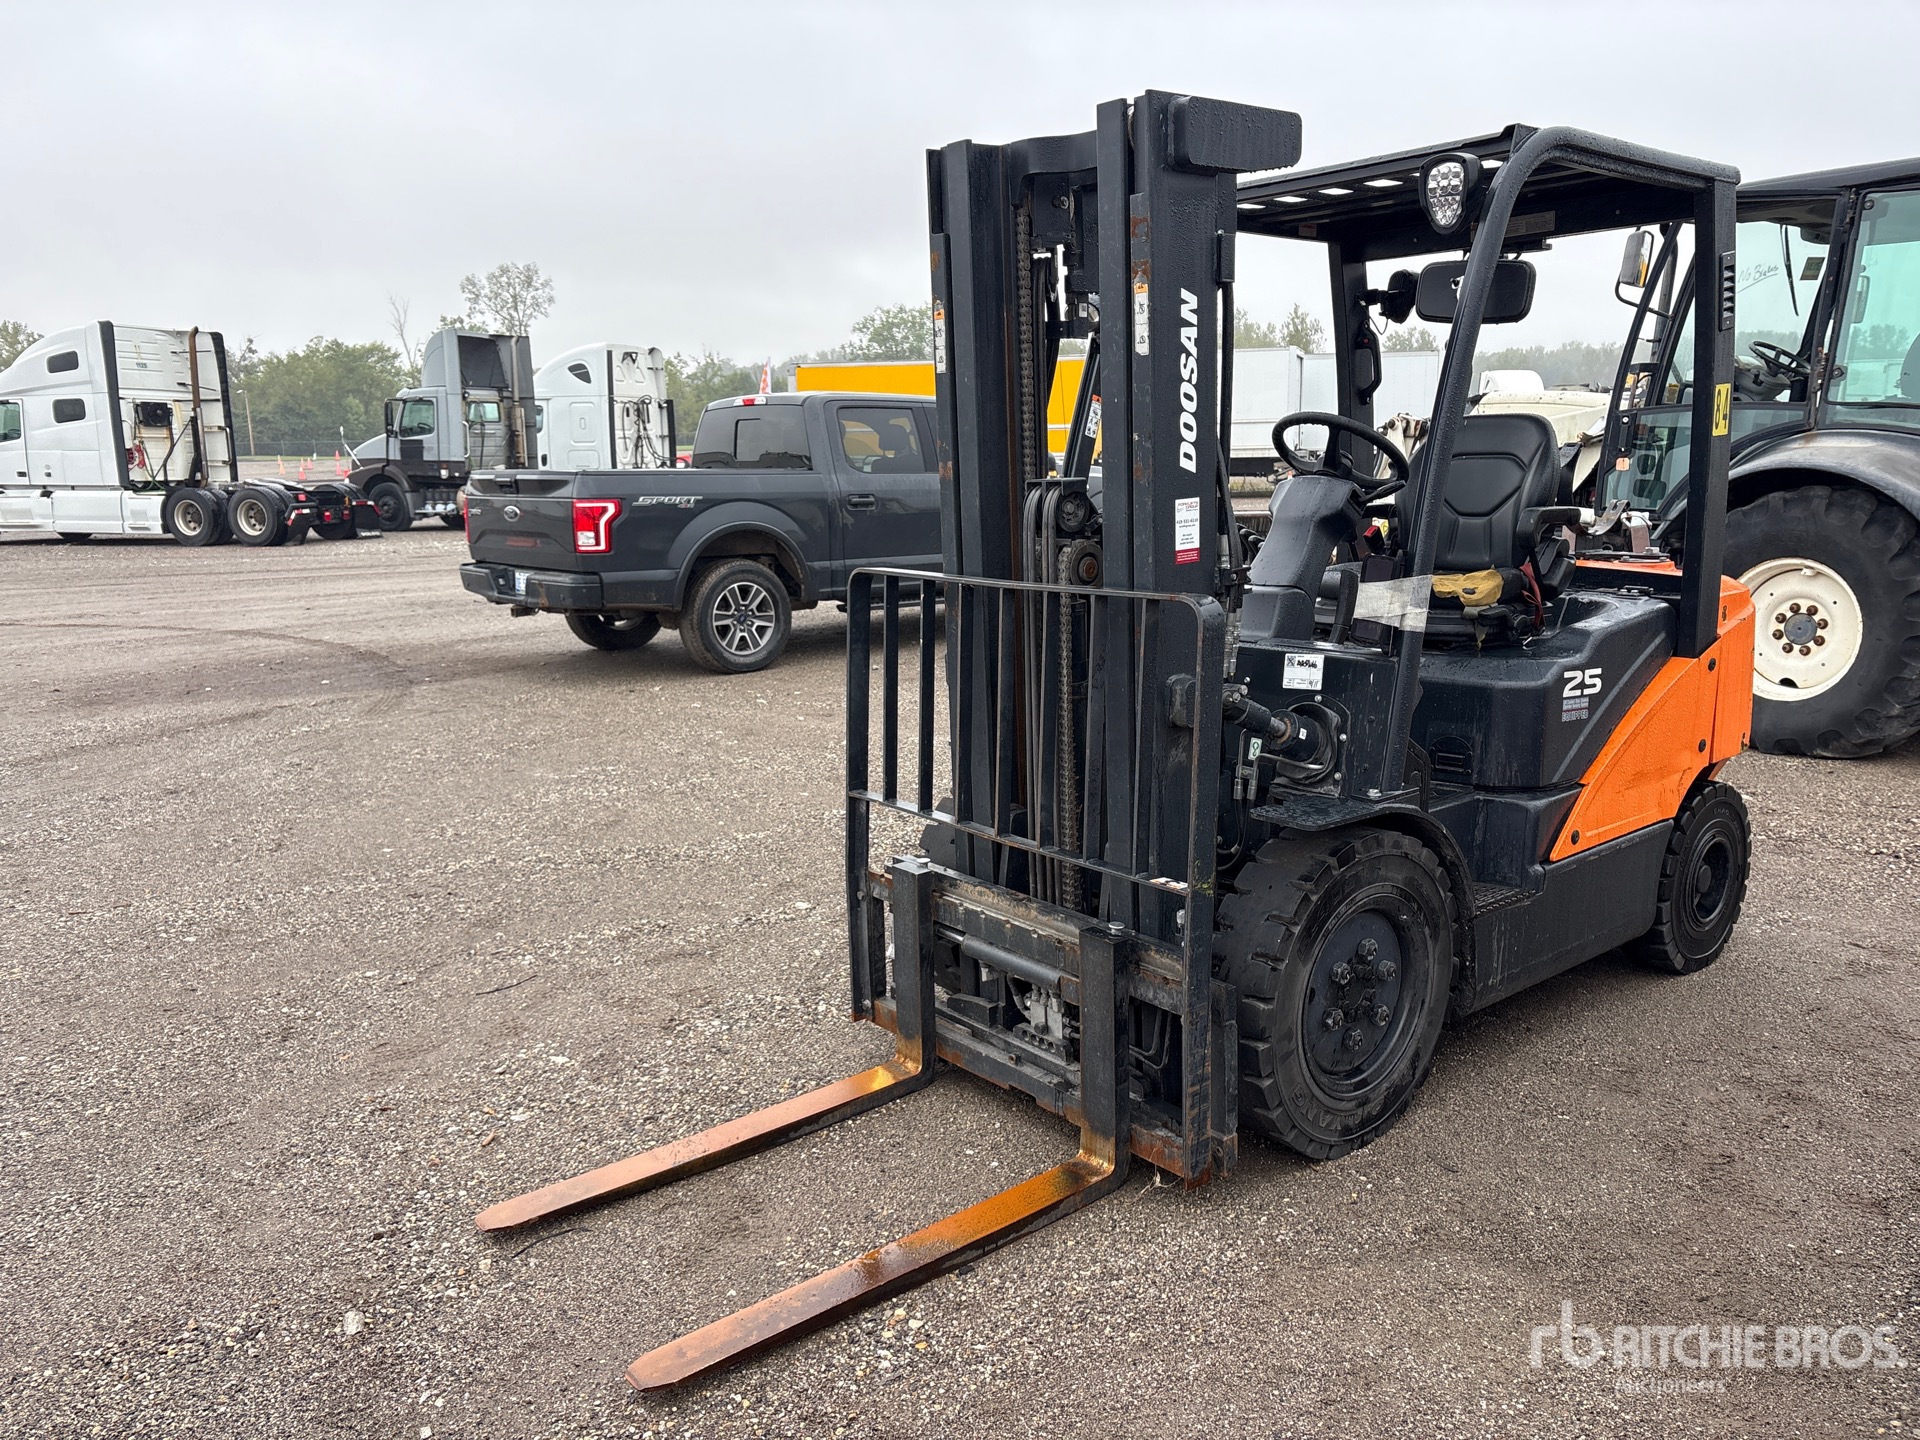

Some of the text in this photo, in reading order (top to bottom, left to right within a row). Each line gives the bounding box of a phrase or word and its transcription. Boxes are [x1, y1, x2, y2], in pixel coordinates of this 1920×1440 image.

[1179, 287, 1198, 473] DOOSAN
[1715, 387, 1730, 430] 84
[632, 496, 703, 507] SPORT
[1563, 667, 1602, 698] 25
